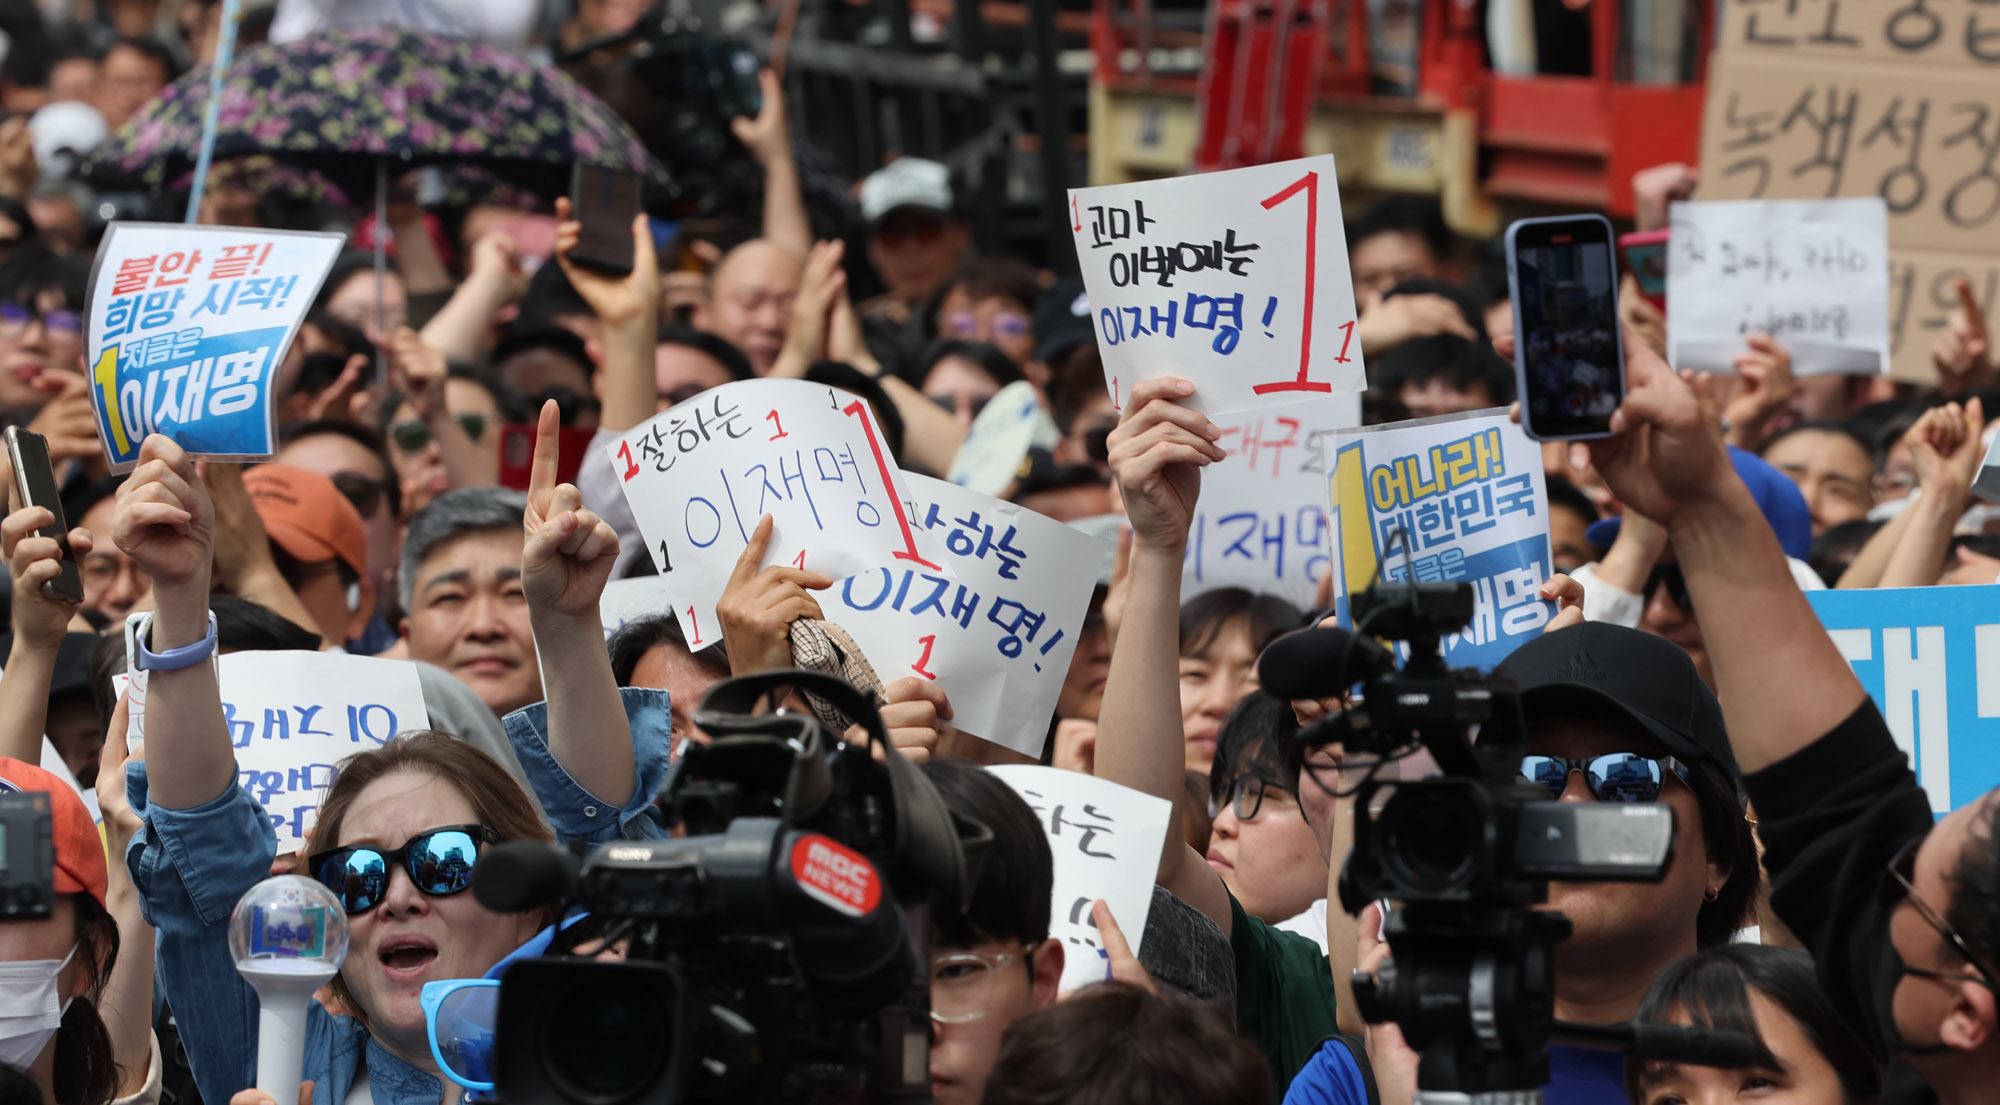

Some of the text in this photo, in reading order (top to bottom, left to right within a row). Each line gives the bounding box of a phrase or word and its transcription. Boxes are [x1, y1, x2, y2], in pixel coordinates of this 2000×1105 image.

[111, 242, 275, 297] 불안 끝!
[1109, 228, 1262, 288] 이번에는
[1252, 170, 1333, 396] 1
[101, 274, 300, 343] 희망 시작!
[122, 327, 203, 373] 지금은
[1333, 320, 1356, 365] 1
[94, 345, 131, 457] 1
[120, 345, 271, 445] 이재명
[765, 409, 790, 442] 1
[636, 394, 753, 473] 잘하는
[684, 441, 881, 549] 이재명
[843, 400, 943, 573] 1
[1371, 429, 1504, 512] 어나라!
[1378, 472, 1536, 560] 대한민국
[659, 539, 674, 574] 1
[686, 605, 703, 646] 1
[841, 566, 1064, 673] 이재명!
[911, 634, 937, 681] 1
[802, 861, 867, 906] NEWS
[806, 841, 872, 888] MBC
